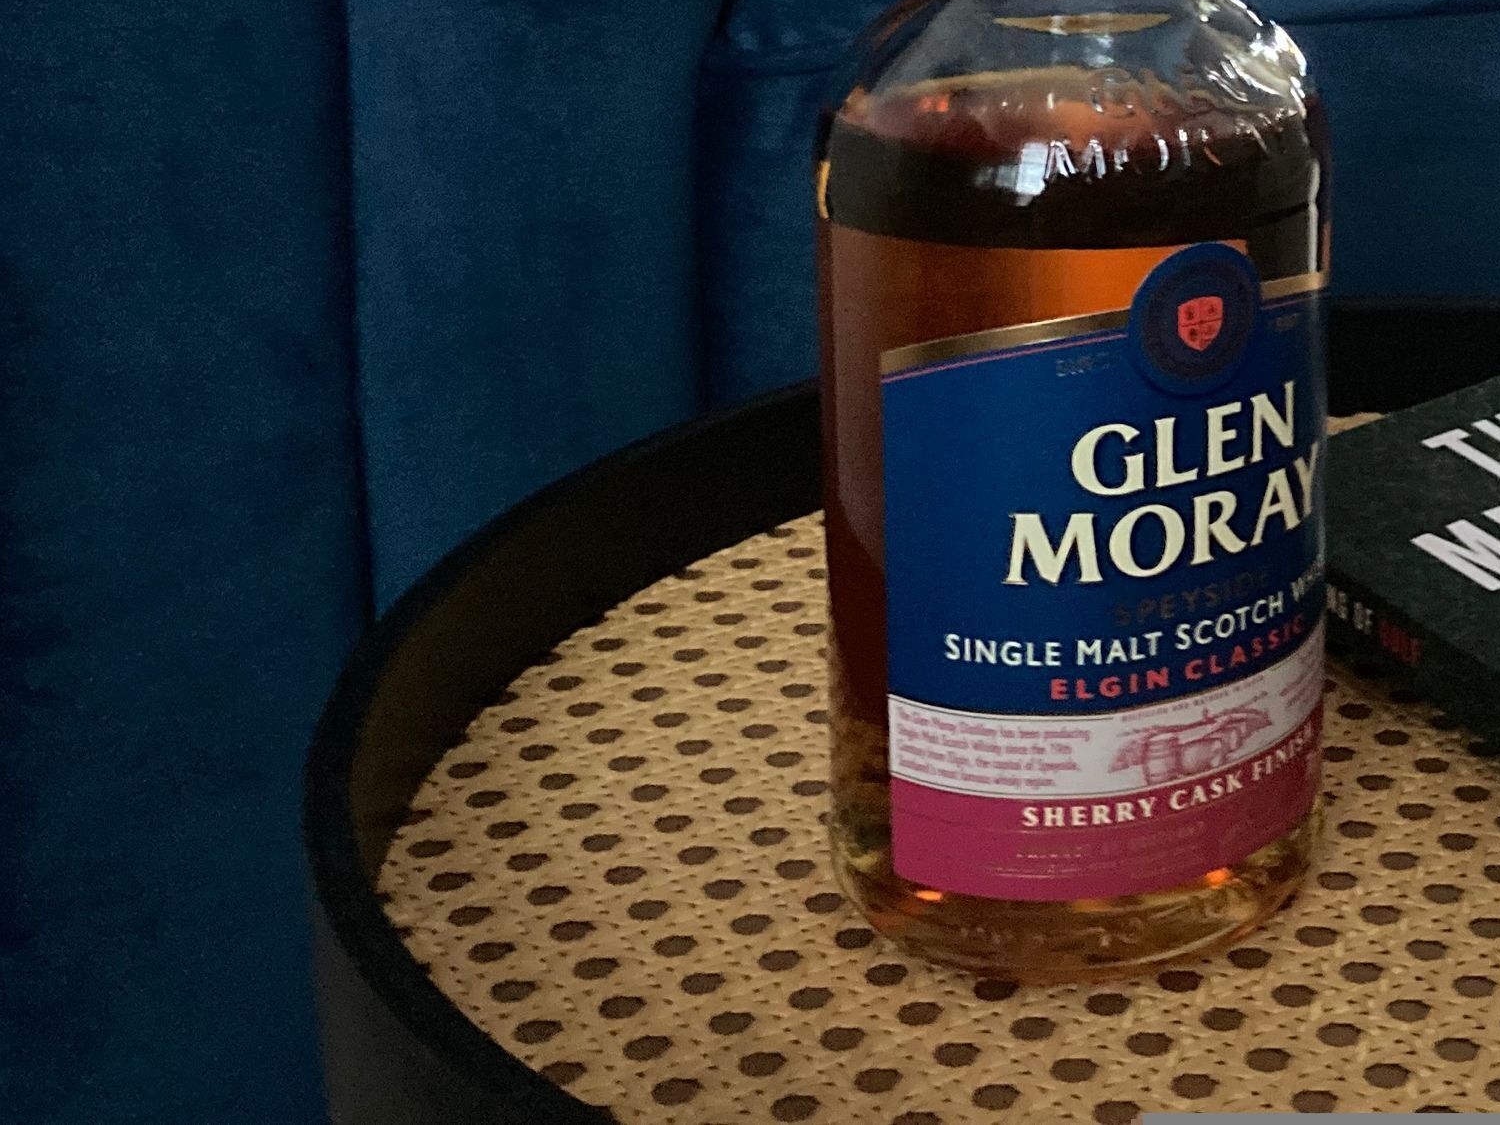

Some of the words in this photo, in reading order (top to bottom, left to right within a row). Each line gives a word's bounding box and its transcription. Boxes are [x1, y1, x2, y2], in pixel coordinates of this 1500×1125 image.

[1071, 380, 1296, 497] GLEN
[1001, 441, 1319, 586] MORAY
[943, 632, 1062, 667] SINGLE
[1075, 631, 1164, 666] MALT
[1174, 590, 1285, 651] SCOTCH
[1049, 665, 1170, 701] ELGIN
[1184, 613, 1305, 681] CLASSIC
[1021, 795, 1158, 828] SHERRY
[1169, 769, 1244, 811] CASK
